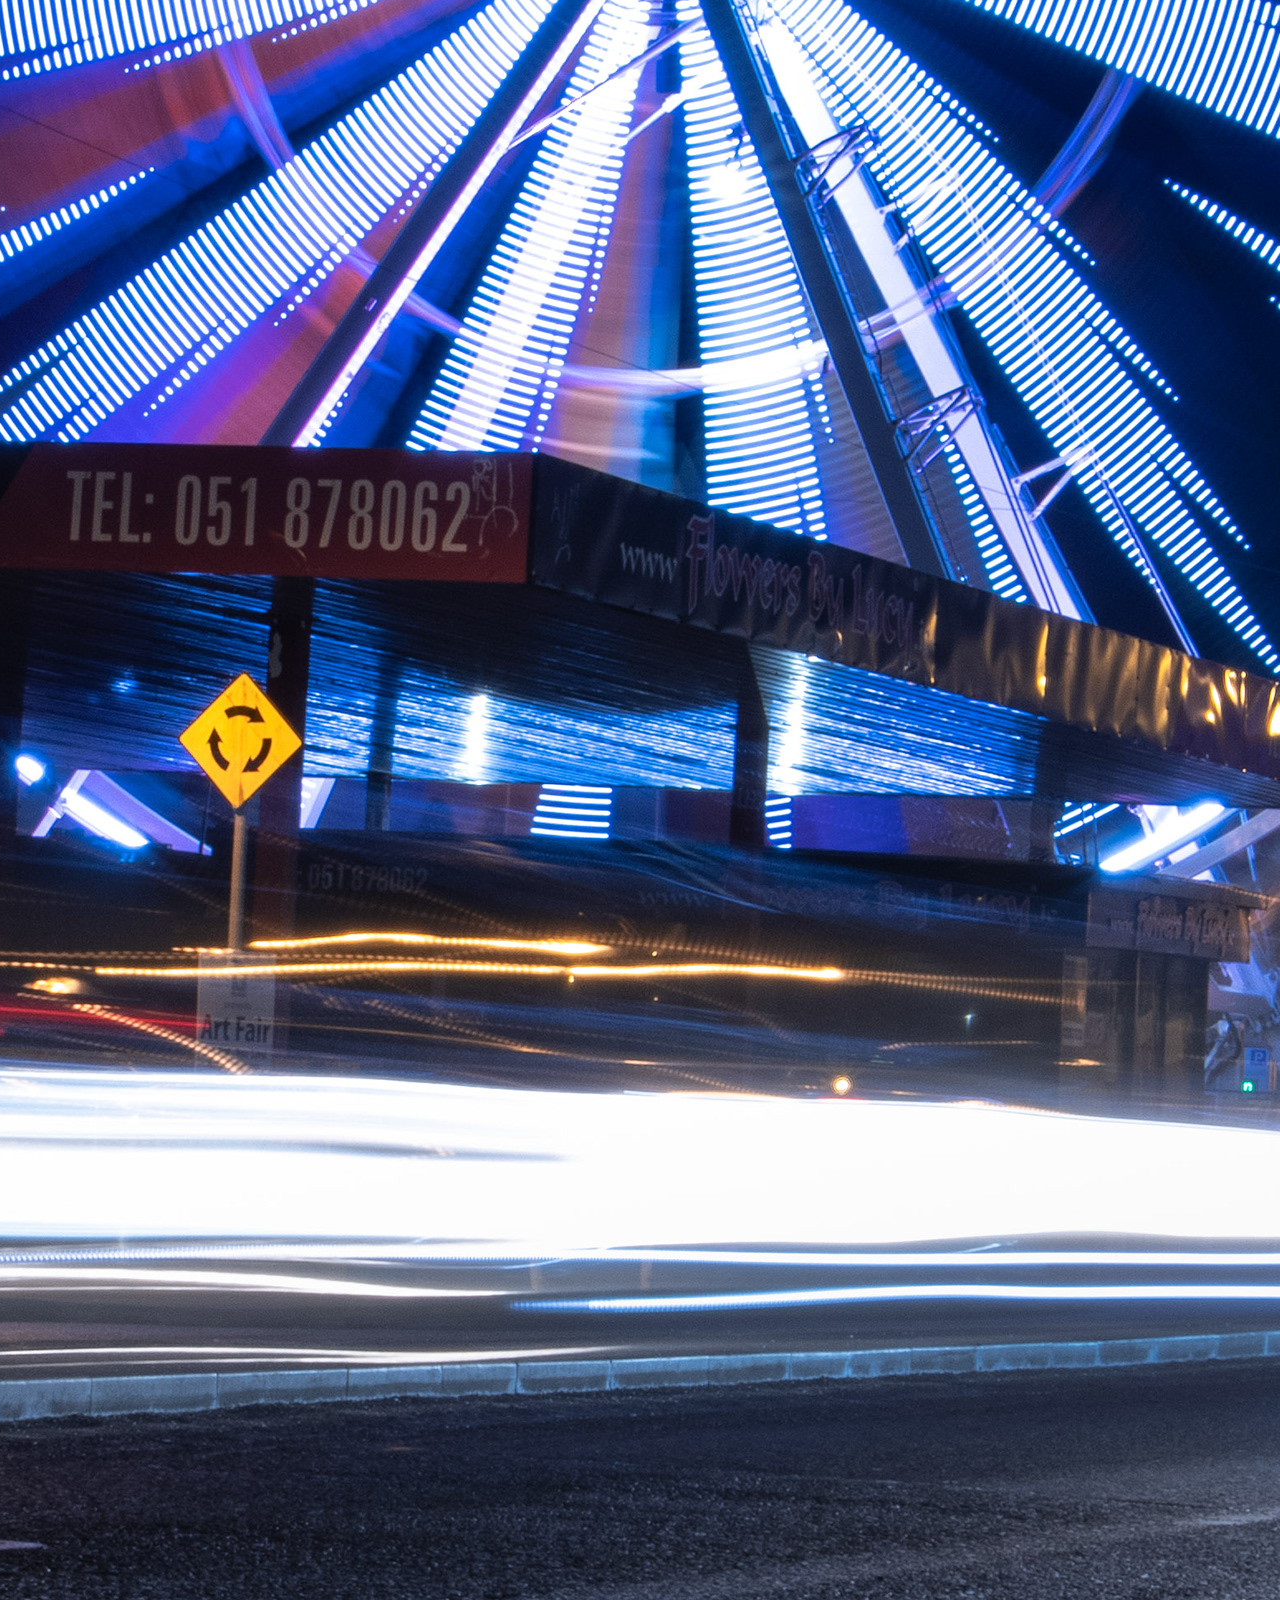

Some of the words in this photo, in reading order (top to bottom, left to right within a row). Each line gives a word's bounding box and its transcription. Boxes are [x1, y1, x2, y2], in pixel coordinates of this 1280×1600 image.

[66, 470, 155, 543] TEL:
[174, 474, 259, 547] 051
[283, 477, 471, 552] 878062
[686, 512, 802, 616] Flowers
[807, 550, 844, 632] By
[308, 863, 345, 890] 051
[200, 1013, 231, 1040] Art
[236, 1016, 271, 1043] Fair
